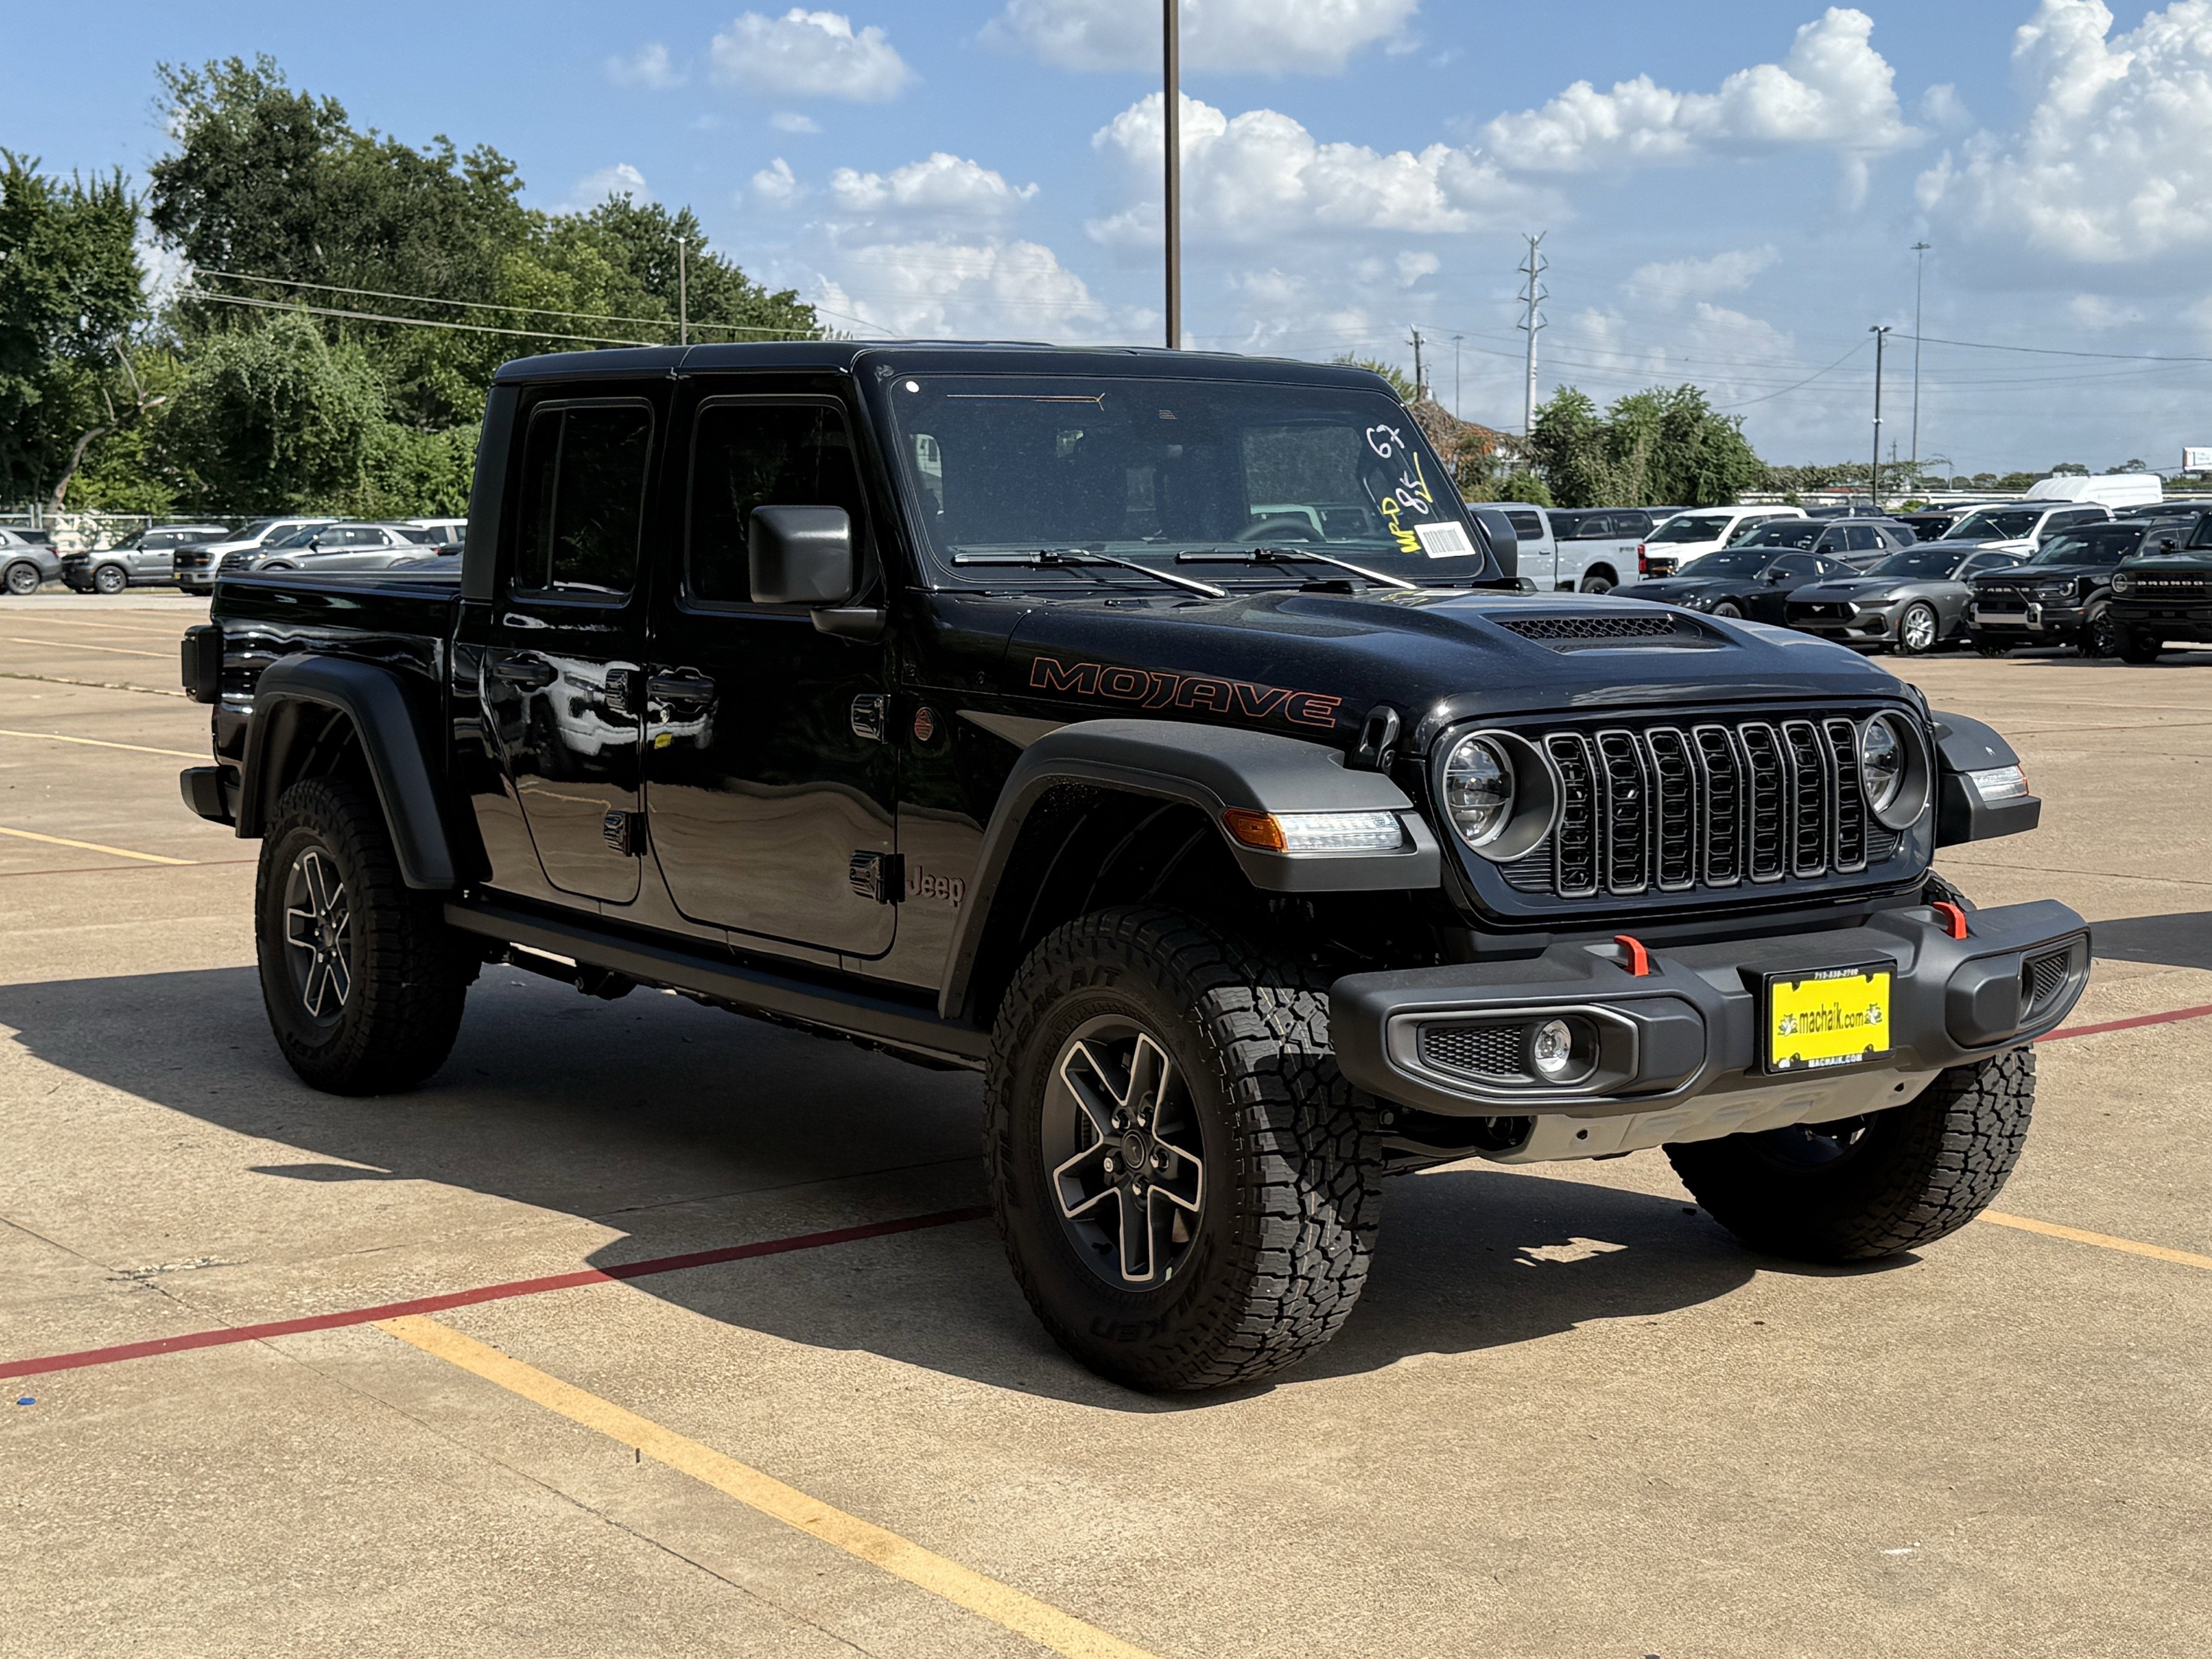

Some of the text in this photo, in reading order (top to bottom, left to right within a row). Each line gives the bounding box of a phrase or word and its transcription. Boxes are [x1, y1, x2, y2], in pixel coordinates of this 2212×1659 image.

[1030, 657, 1342, 728] MOJAVE
[906, 865, 966, 907] Jeep
[1799, 1001, 1864, 1034] machaik.com
